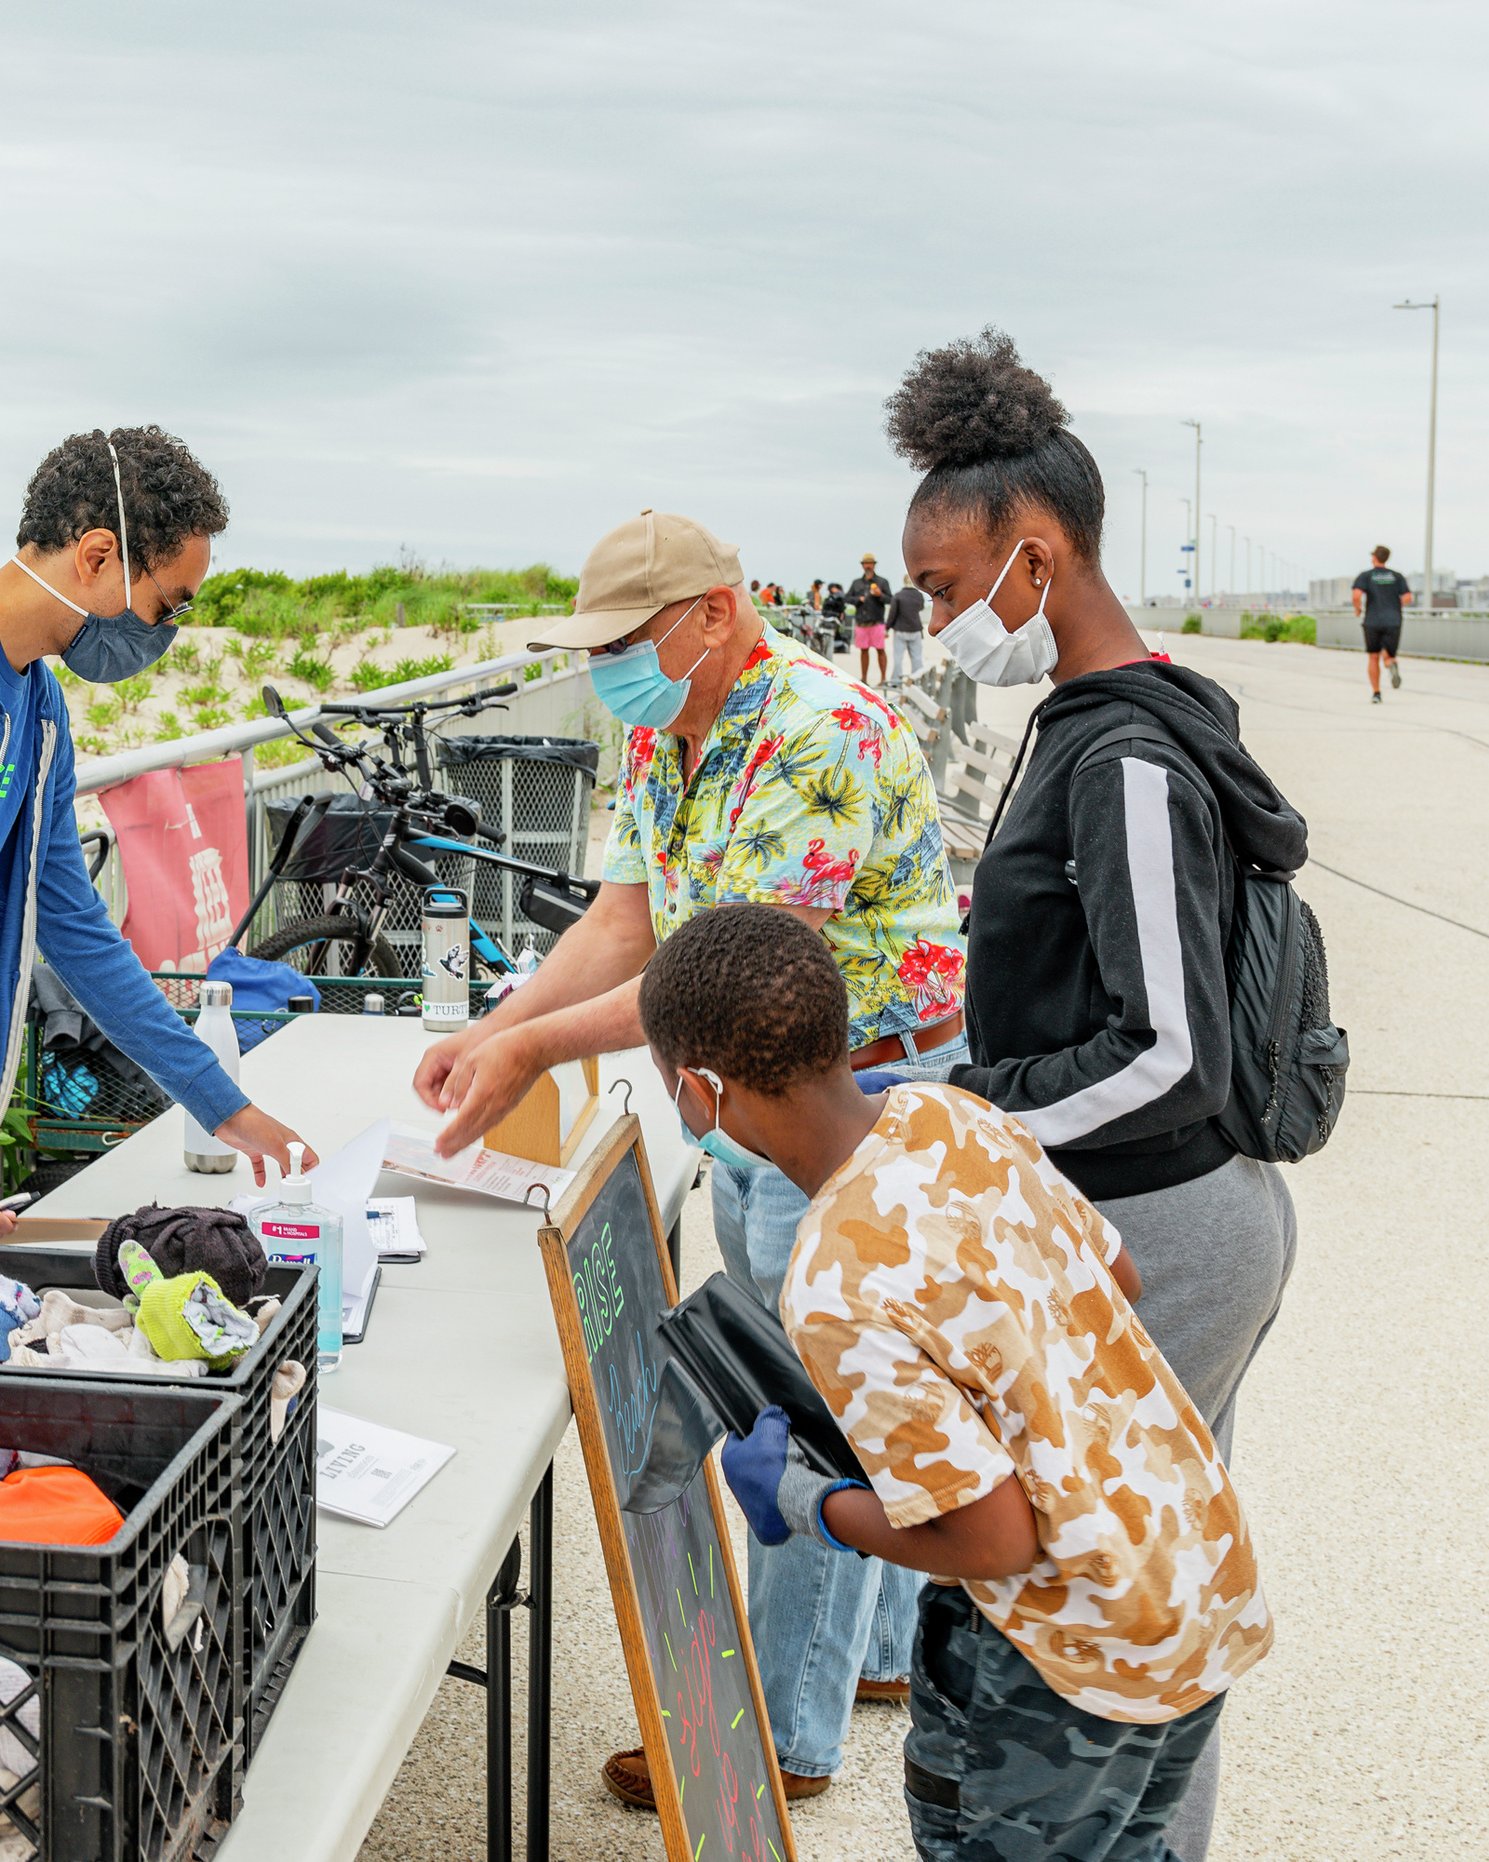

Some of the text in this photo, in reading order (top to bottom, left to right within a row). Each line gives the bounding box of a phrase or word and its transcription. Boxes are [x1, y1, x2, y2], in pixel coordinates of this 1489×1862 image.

[272, 1225, 282, 1235] #1
[572, 1221, 625, 1364] RISE
[319, 1443, 366, 1479] LIVING
[676, 1608, 716, 1777] sign
